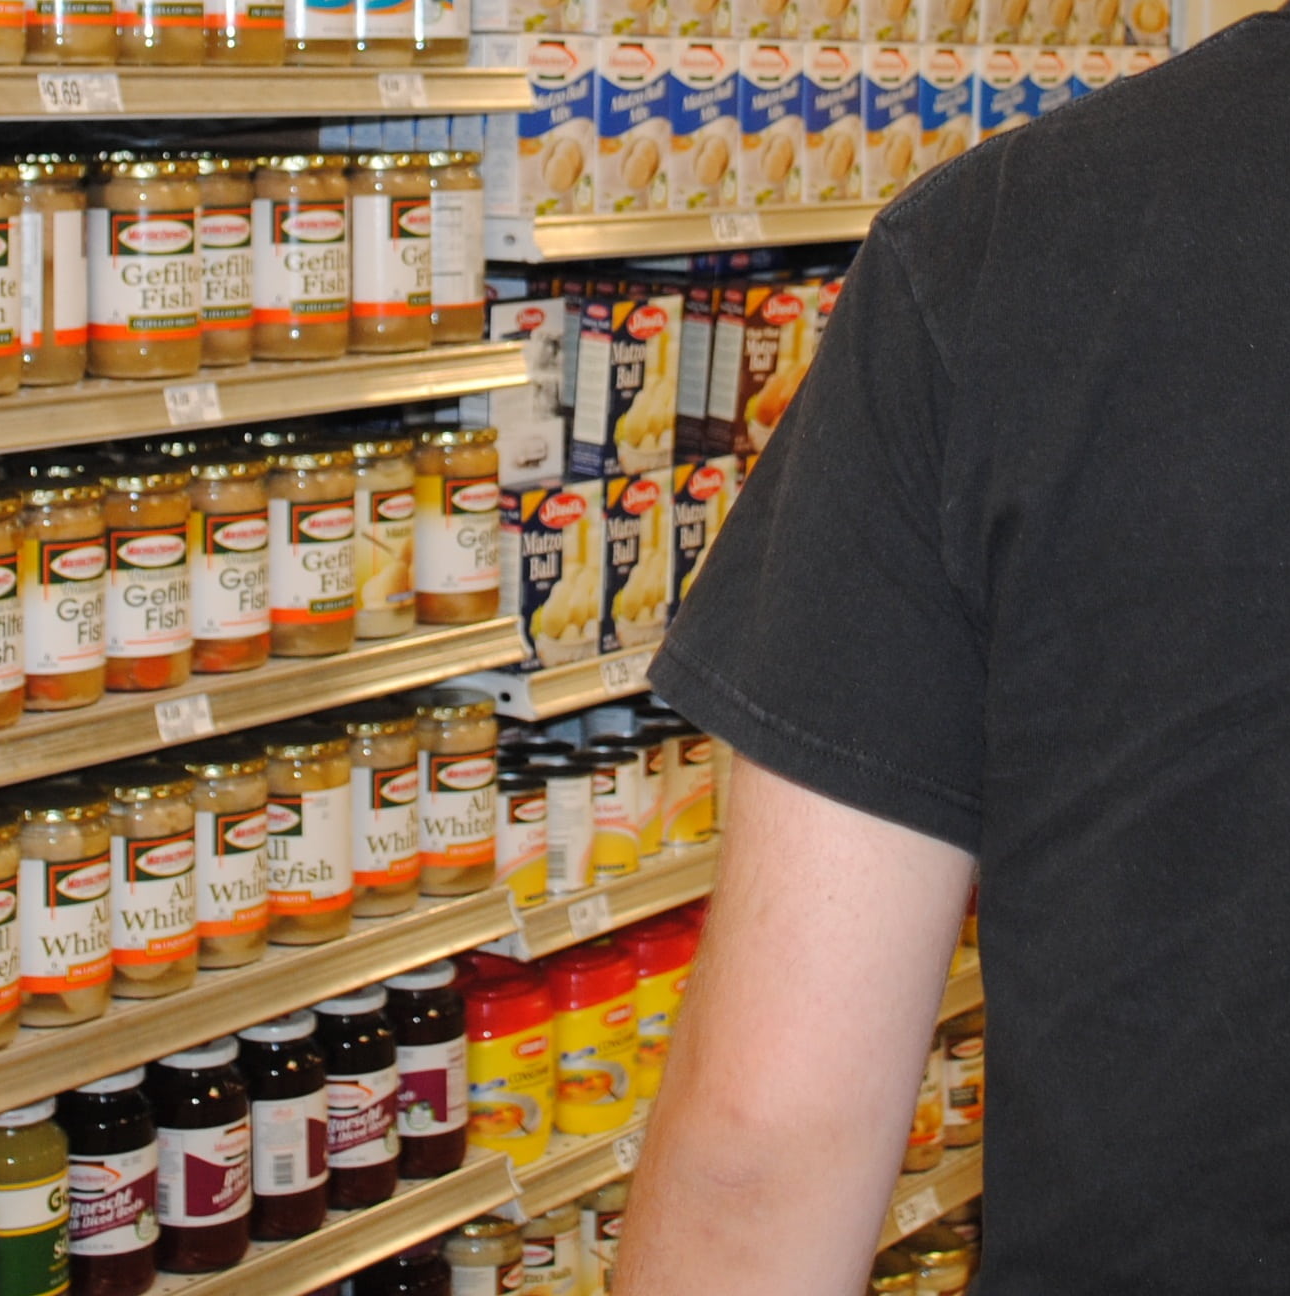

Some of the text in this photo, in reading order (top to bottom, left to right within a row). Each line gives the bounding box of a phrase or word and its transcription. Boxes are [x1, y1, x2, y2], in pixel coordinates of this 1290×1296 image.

[42, 80, 82, 108] $9.69
[302, 273, 346, 296] Fish
[140, 287, 193, 310] Fish
[612, 341, 646, 365] Matzo
[616, 364, 641, 389] Ball
[523, 532, 562, 555] Matzo
[529, 556, 558, 581] Ball
[145, 605, 187, 631] Fish
